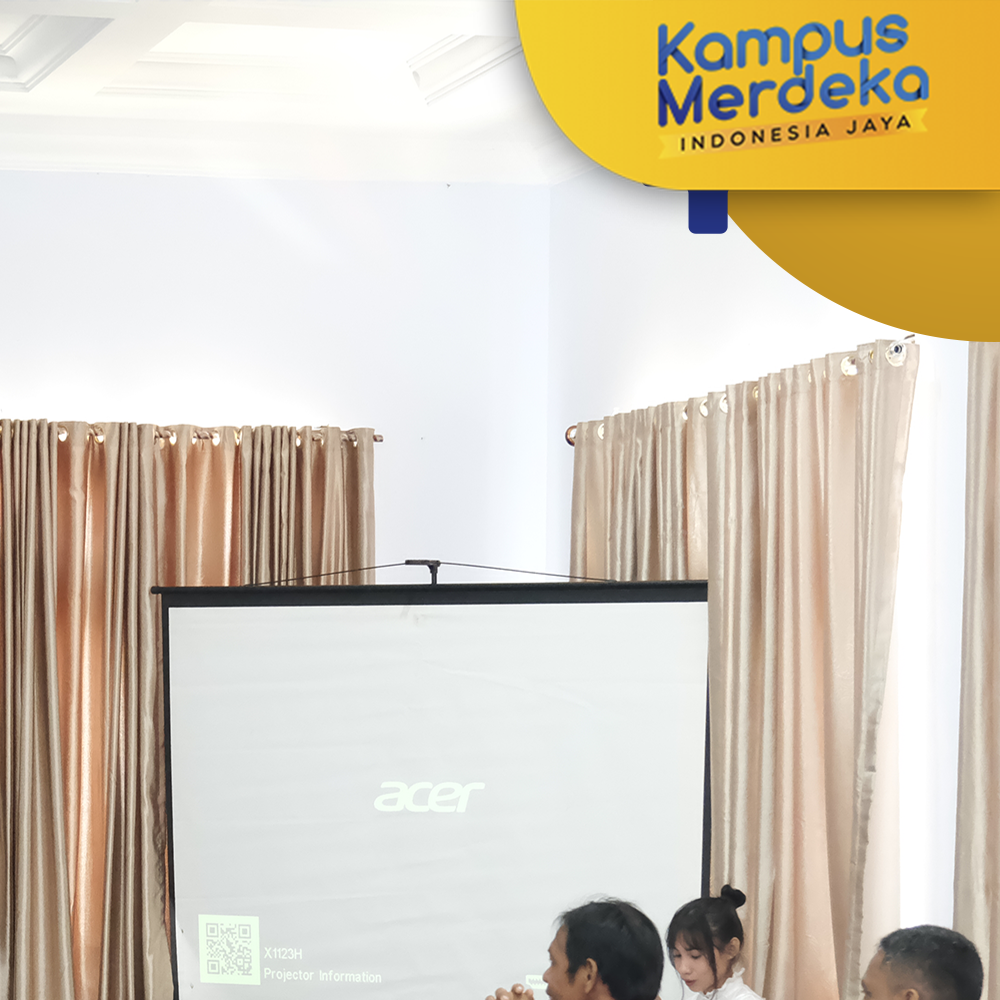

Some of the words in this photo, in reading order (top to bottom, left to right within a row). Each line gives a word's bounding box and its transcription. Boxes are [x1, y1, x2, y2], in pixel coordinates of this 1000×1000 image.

[374, 780, 486, 813] acer
[263, 946, 303, 960] X1123H
[263, 967, 315, 983] Projector
[319, 969, 382, 984] Information
